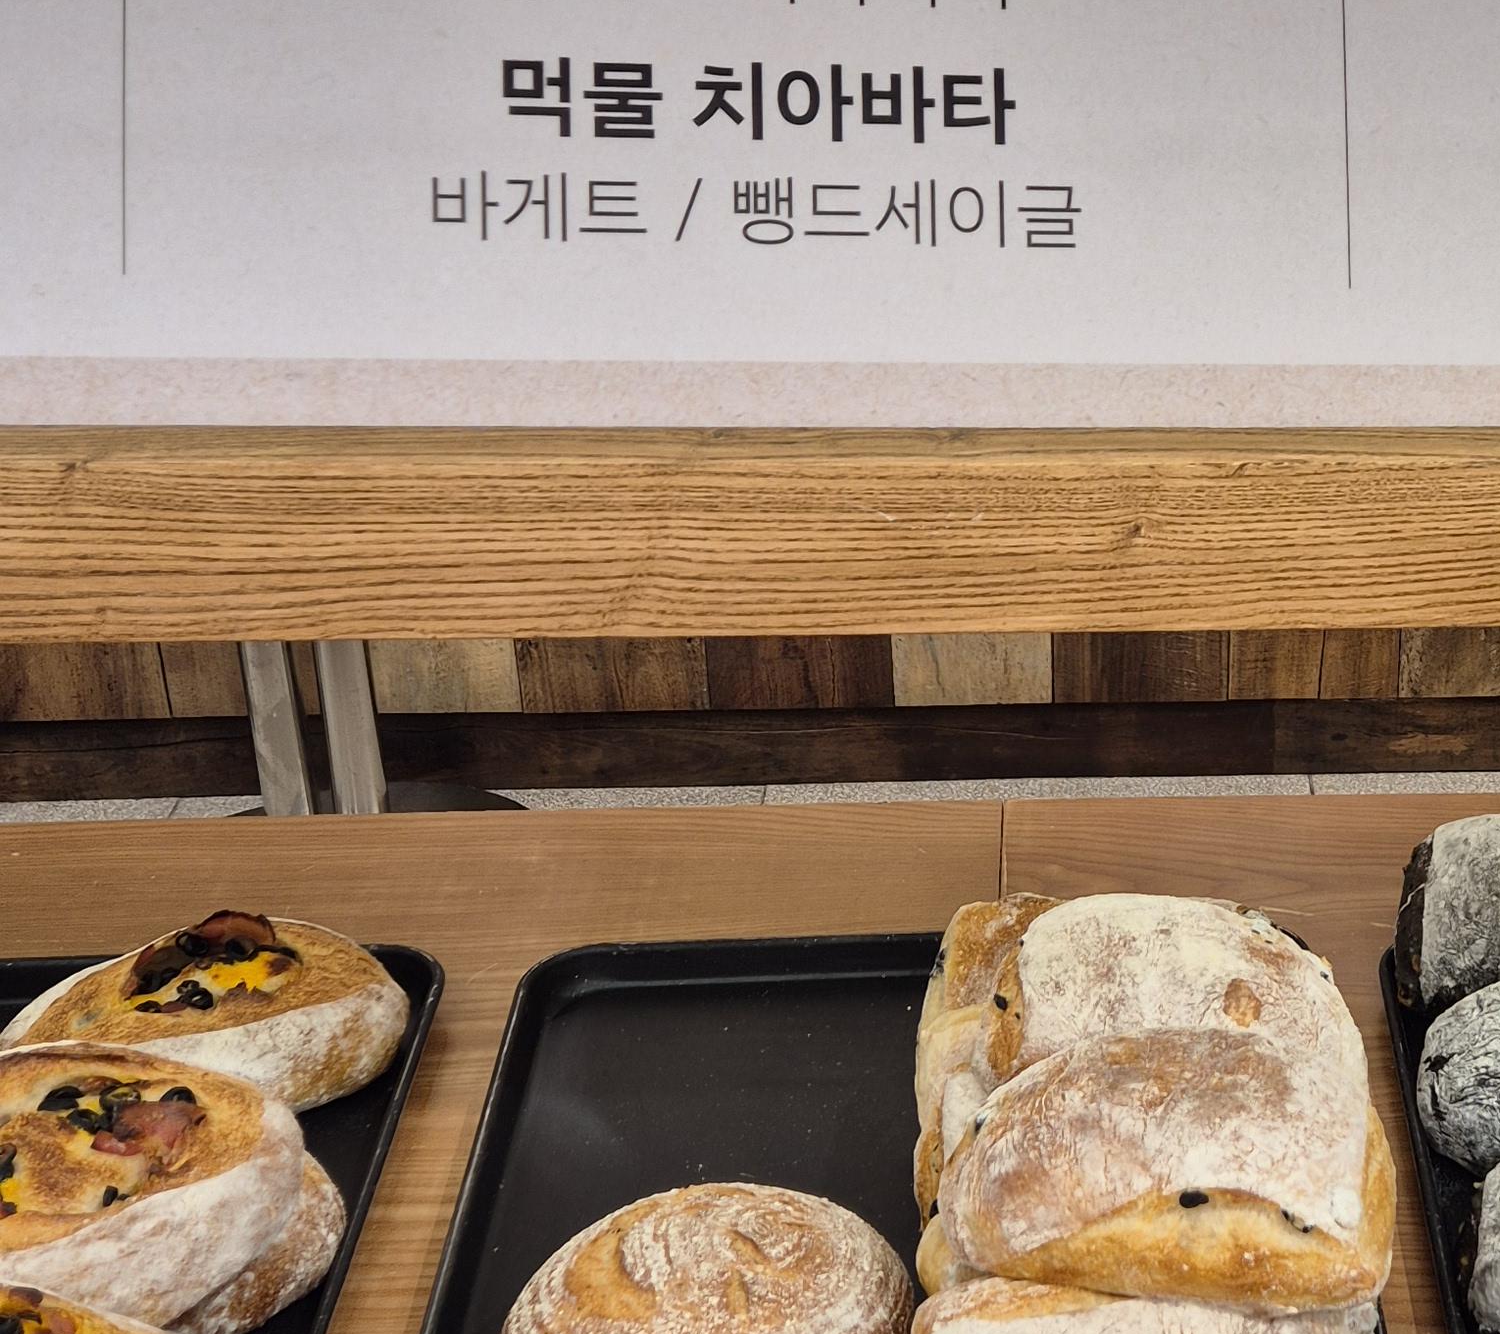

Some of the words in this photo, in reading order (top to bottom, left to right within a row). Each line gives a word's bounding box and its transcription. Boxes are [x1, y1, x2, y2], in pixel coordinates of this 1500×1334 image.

[501, 57, 664, 139] 먹물
[692, 63, 1017, 145] 치아바타
[431, 170, 648, 243] 바게트
[733, 177, 1083, 249] 뺑드세이글
